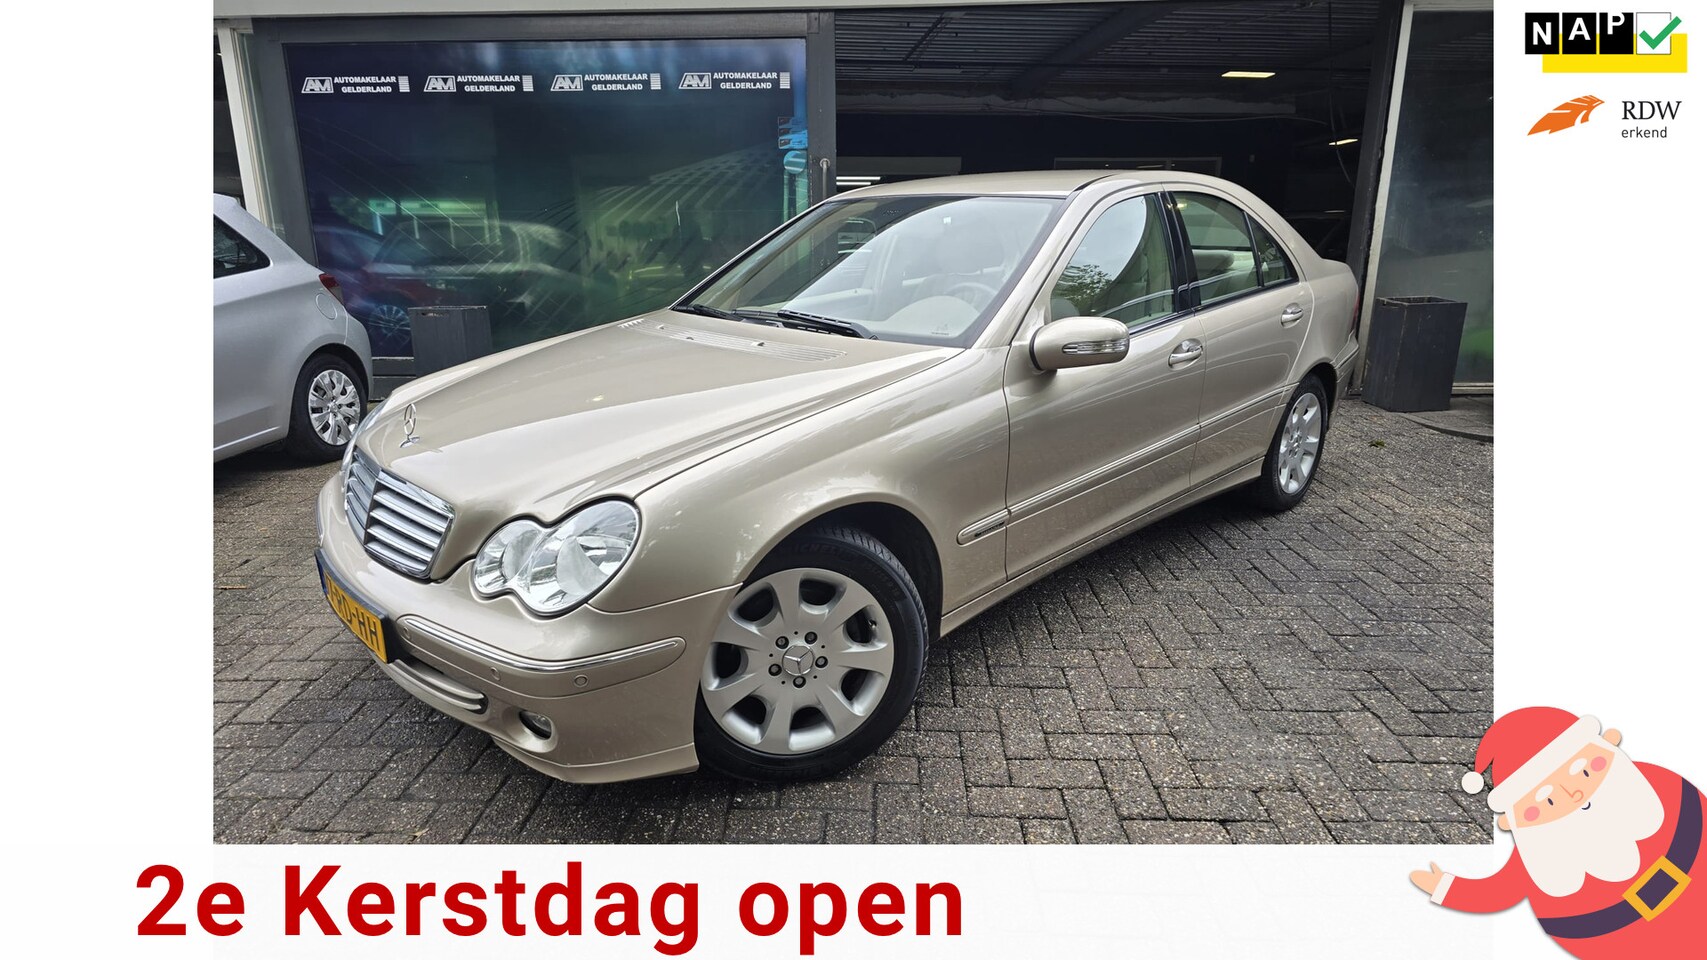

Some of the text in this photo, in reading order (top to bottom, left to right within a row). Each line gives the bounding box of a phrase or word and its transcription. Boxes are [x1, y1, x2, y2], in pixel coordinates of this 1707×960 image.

[334, 76, 396, 84] AUTOMAKELAAR
[457, 75, 520, 83] AUTOMAKELAAR
[584, 74, 648, 82] AUTOMAKELAAR
[713, 72, 777, 80] AUTOMAKELAAR
[304, 78, 332, 92] AM
[427, 77, 455, 91] AM
[554, 76, 582, 90] AM
[682, 74, 711, 88] AM
[342, 86, 392, 94] GELDERLAND
[720, 82, 772, 90] GELDERLAND
